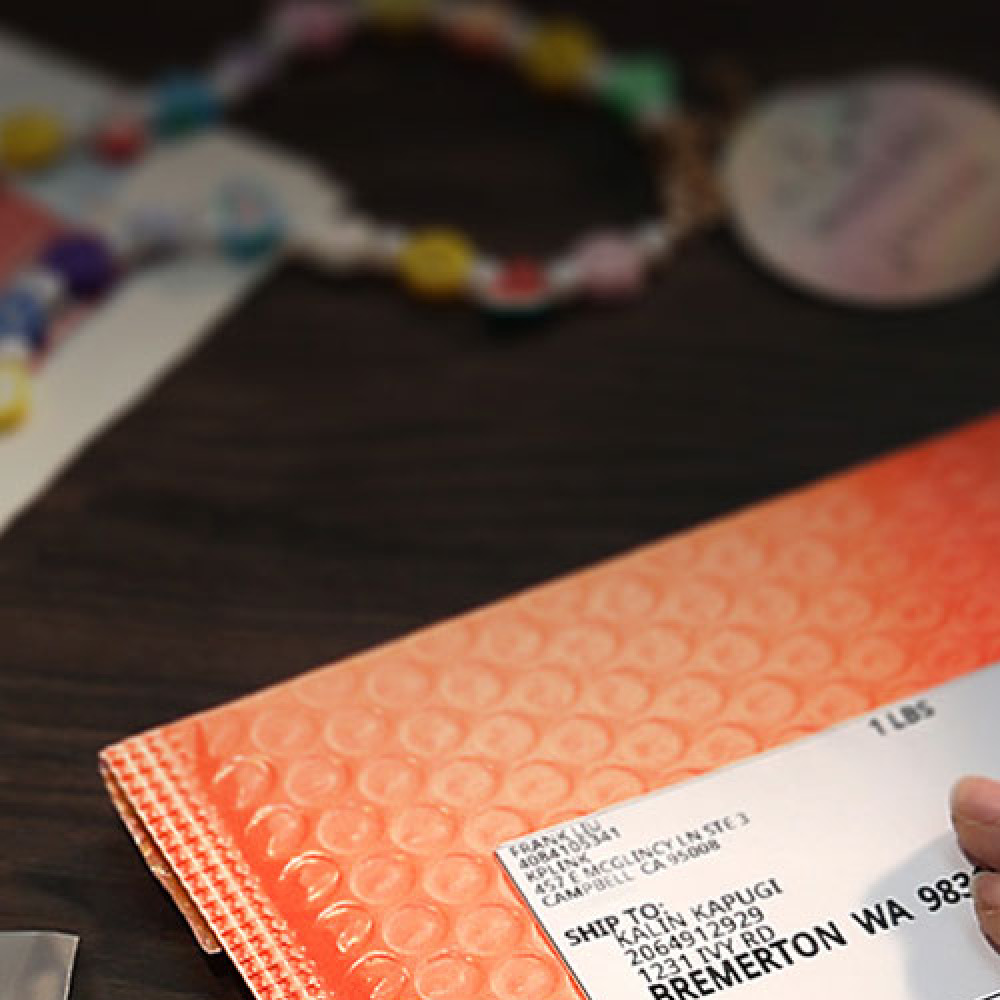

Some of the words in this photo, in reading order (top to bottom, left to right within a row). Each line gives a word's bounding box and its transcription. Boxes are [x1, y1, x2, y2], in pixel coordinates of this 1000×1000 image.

[868, 717, 887, 735] 1
[887, 699, 936, 729] LBS
[541, 871, 635, 907] CAMPBELL
[640, 859, 667, 875] CA
[850, 899, 915, 935] WA
[917, 866, 976, 912] 983
[564, 915, 619, 946] SHIP
[622, 902, 664, 924] TO:
[612, 910, 688, 948] KALIN
[690, 878, 783, 921] KAPUGI
[624, 906, 765, 966] 2064912929
[637, 953, 693, 984] 1231
[698, 937, 735, 965] IVY
[739, 925, 776, 949] RD
